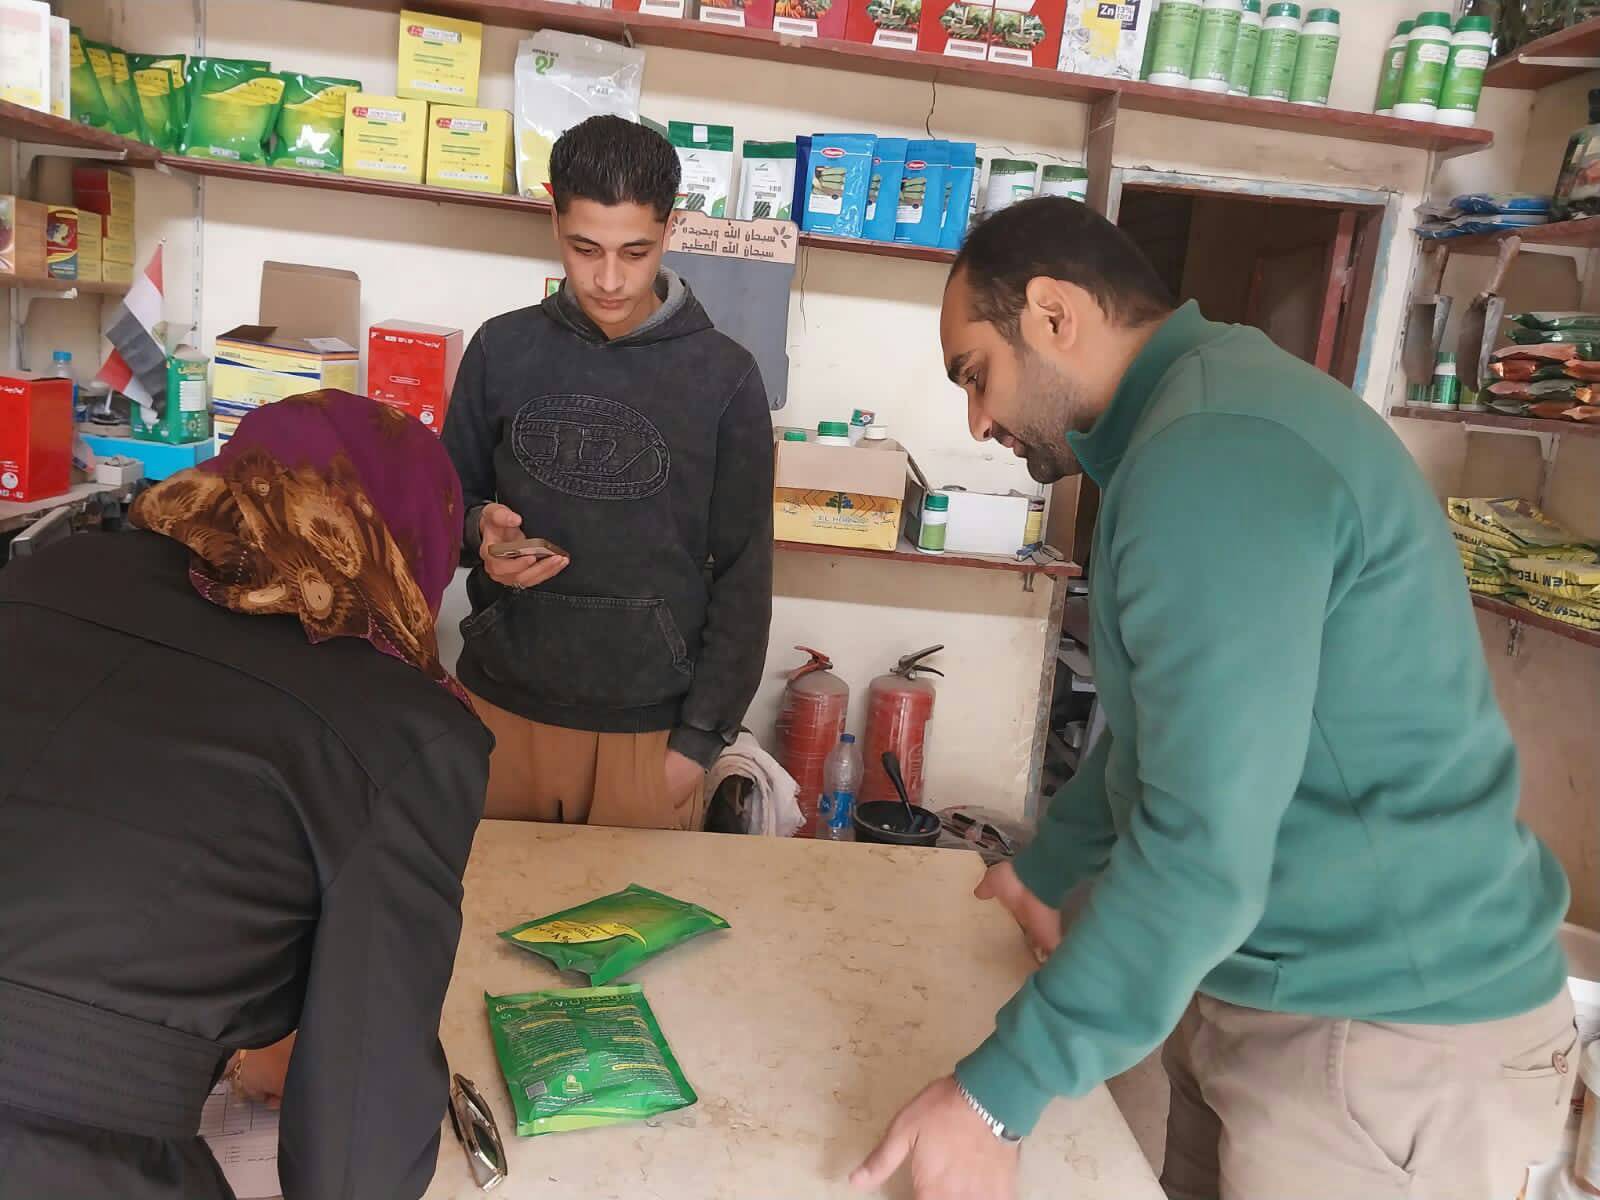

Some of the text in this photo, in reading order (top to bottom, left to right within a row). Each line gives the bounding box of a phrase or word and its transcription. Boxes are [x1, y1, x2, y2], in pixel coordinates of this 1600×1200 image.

[1100, 4, 1114, 16] Zn
[682, 225, 776, 243] سبحان الله وبحمده
[681, 238, 774, 257] سبحان الله العظيم
[1517, 570, 1539, 584] TEC
